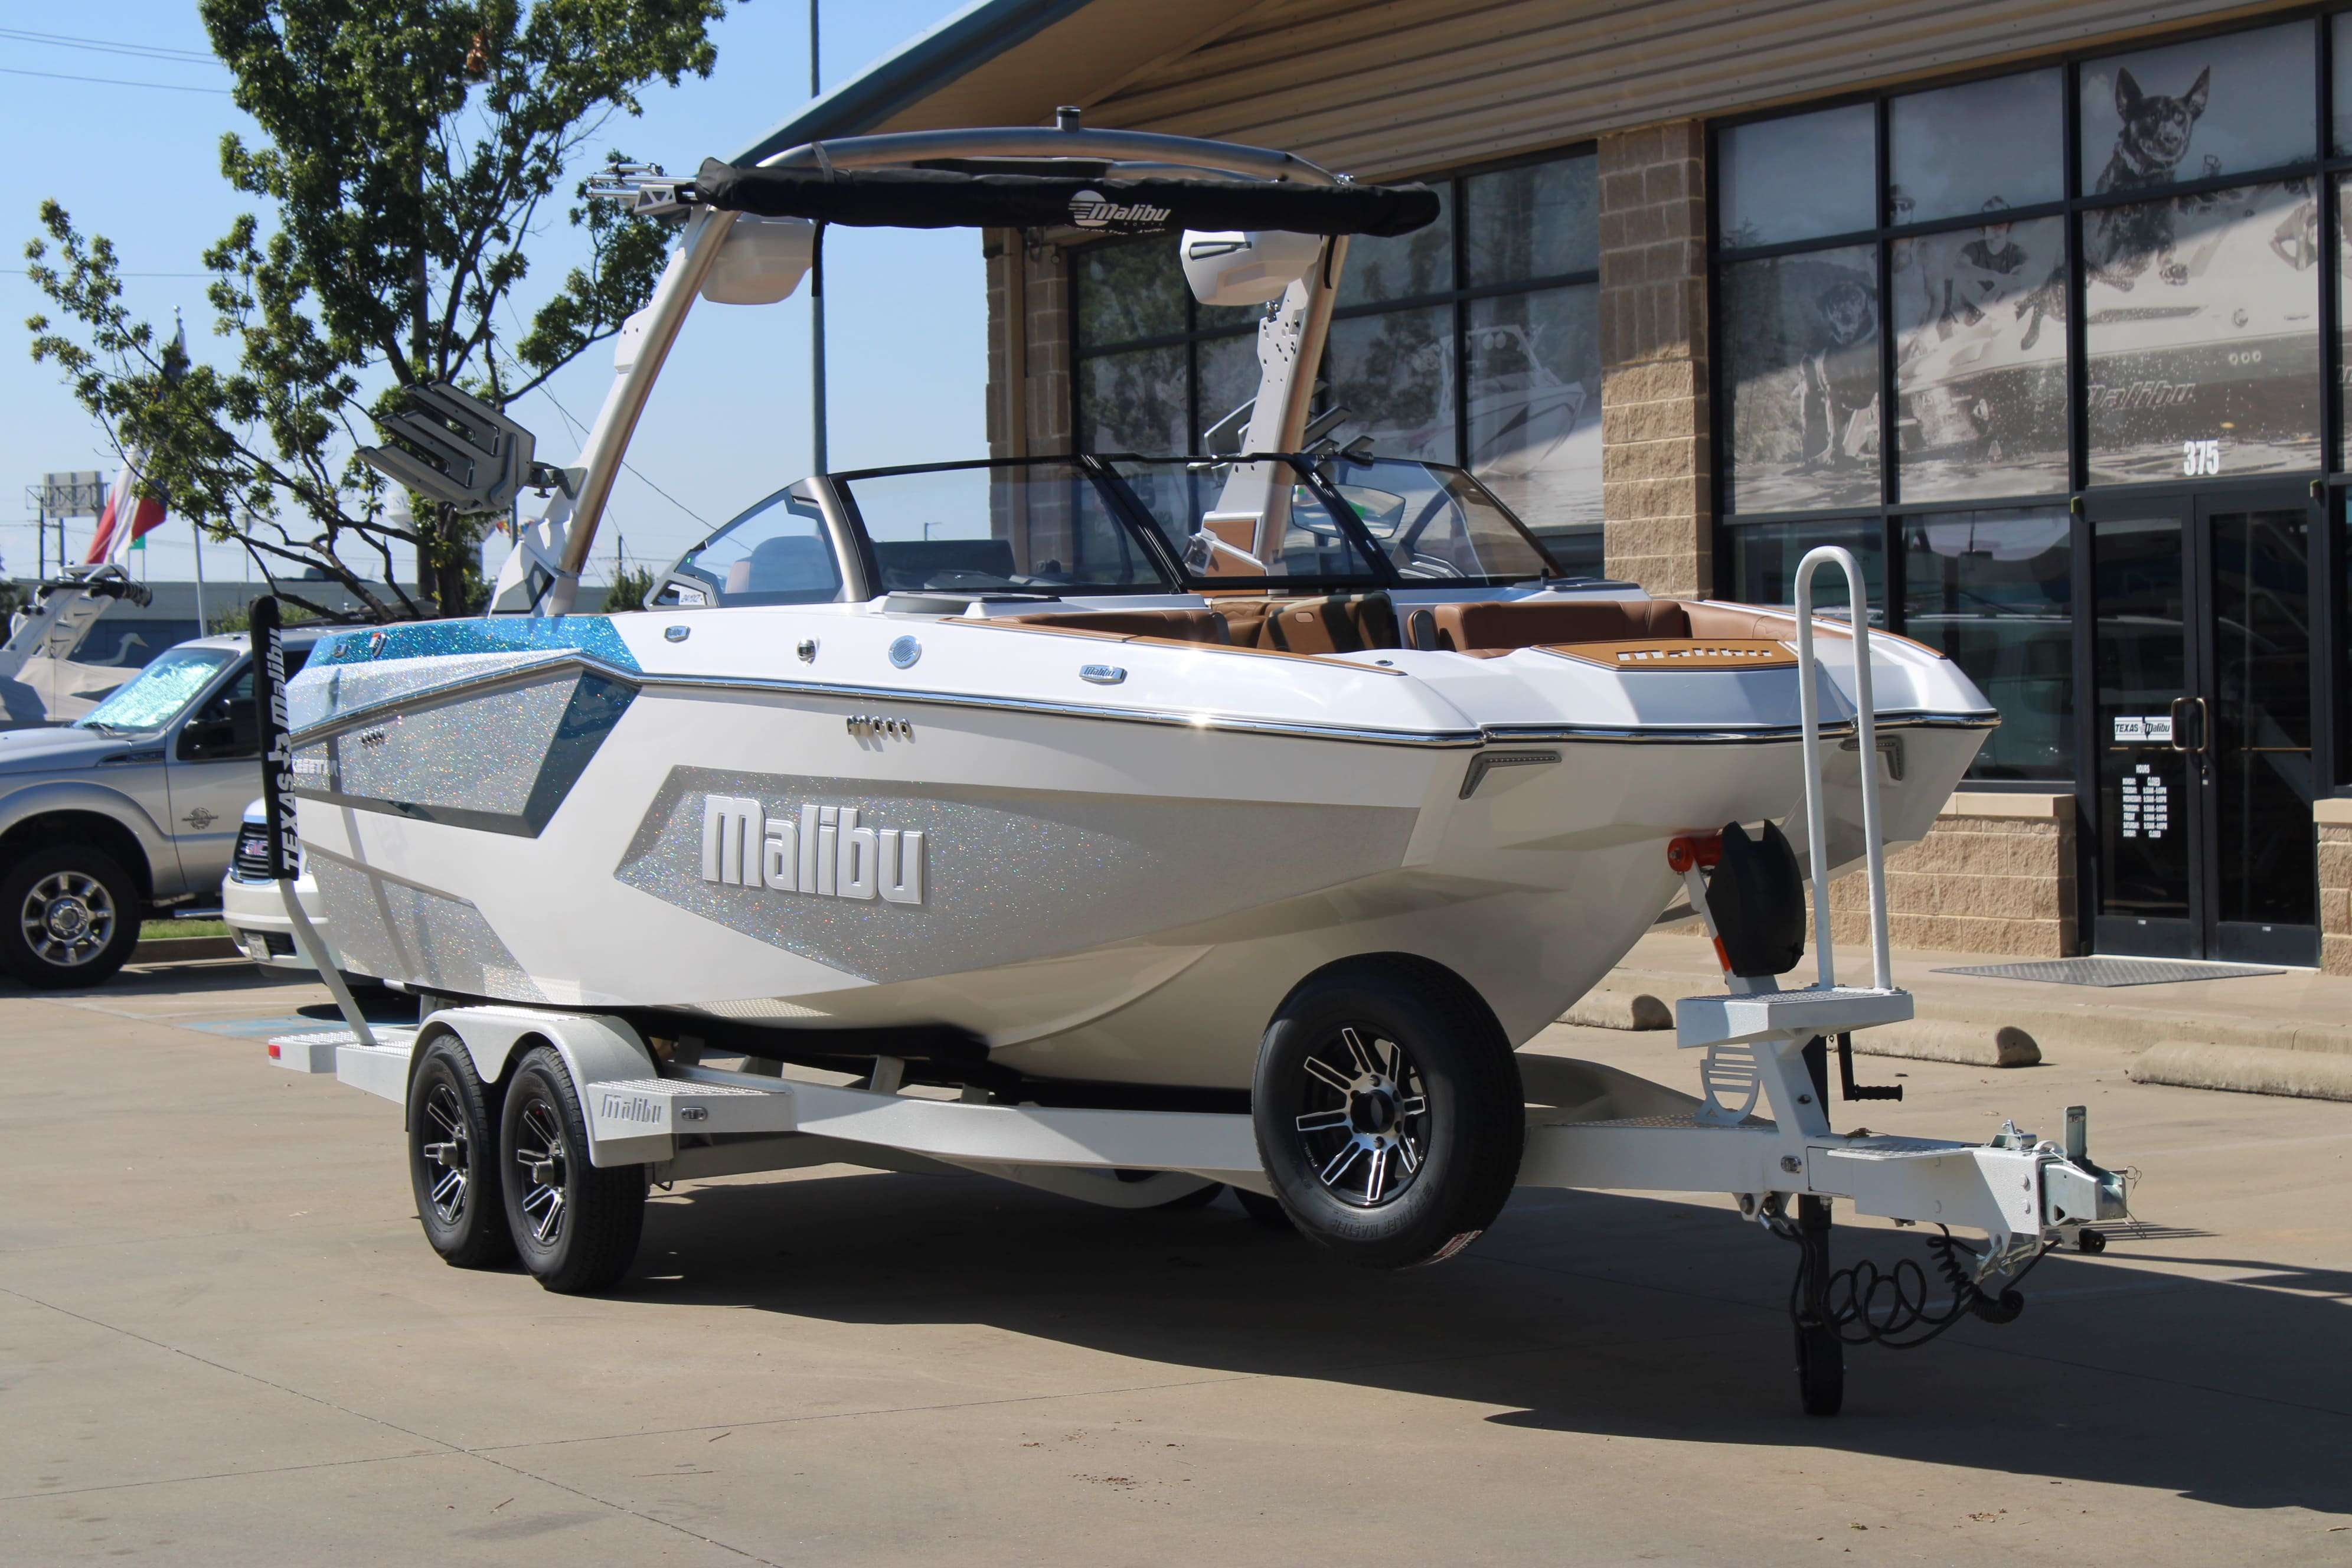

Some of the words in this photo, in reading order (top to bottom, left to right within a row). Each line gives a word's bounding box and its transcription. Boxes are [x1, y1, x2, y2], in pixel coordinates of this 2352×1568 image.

[1088, 203, 1171, 221] Malibu
[2184, 440, 2219, 476] 375
[266, 627, 289, 730] Malibu
[2116, 723, 2138, 733] TEXAS
[2145, 723, 2171, 733] Malibu
[2136, 765, 2150, 773] HOURS
[277, 773, 299, 871] TEXAS
[703, 795, 924, 905] Malibu
[601, 1093, 662, 1123] Malibu
